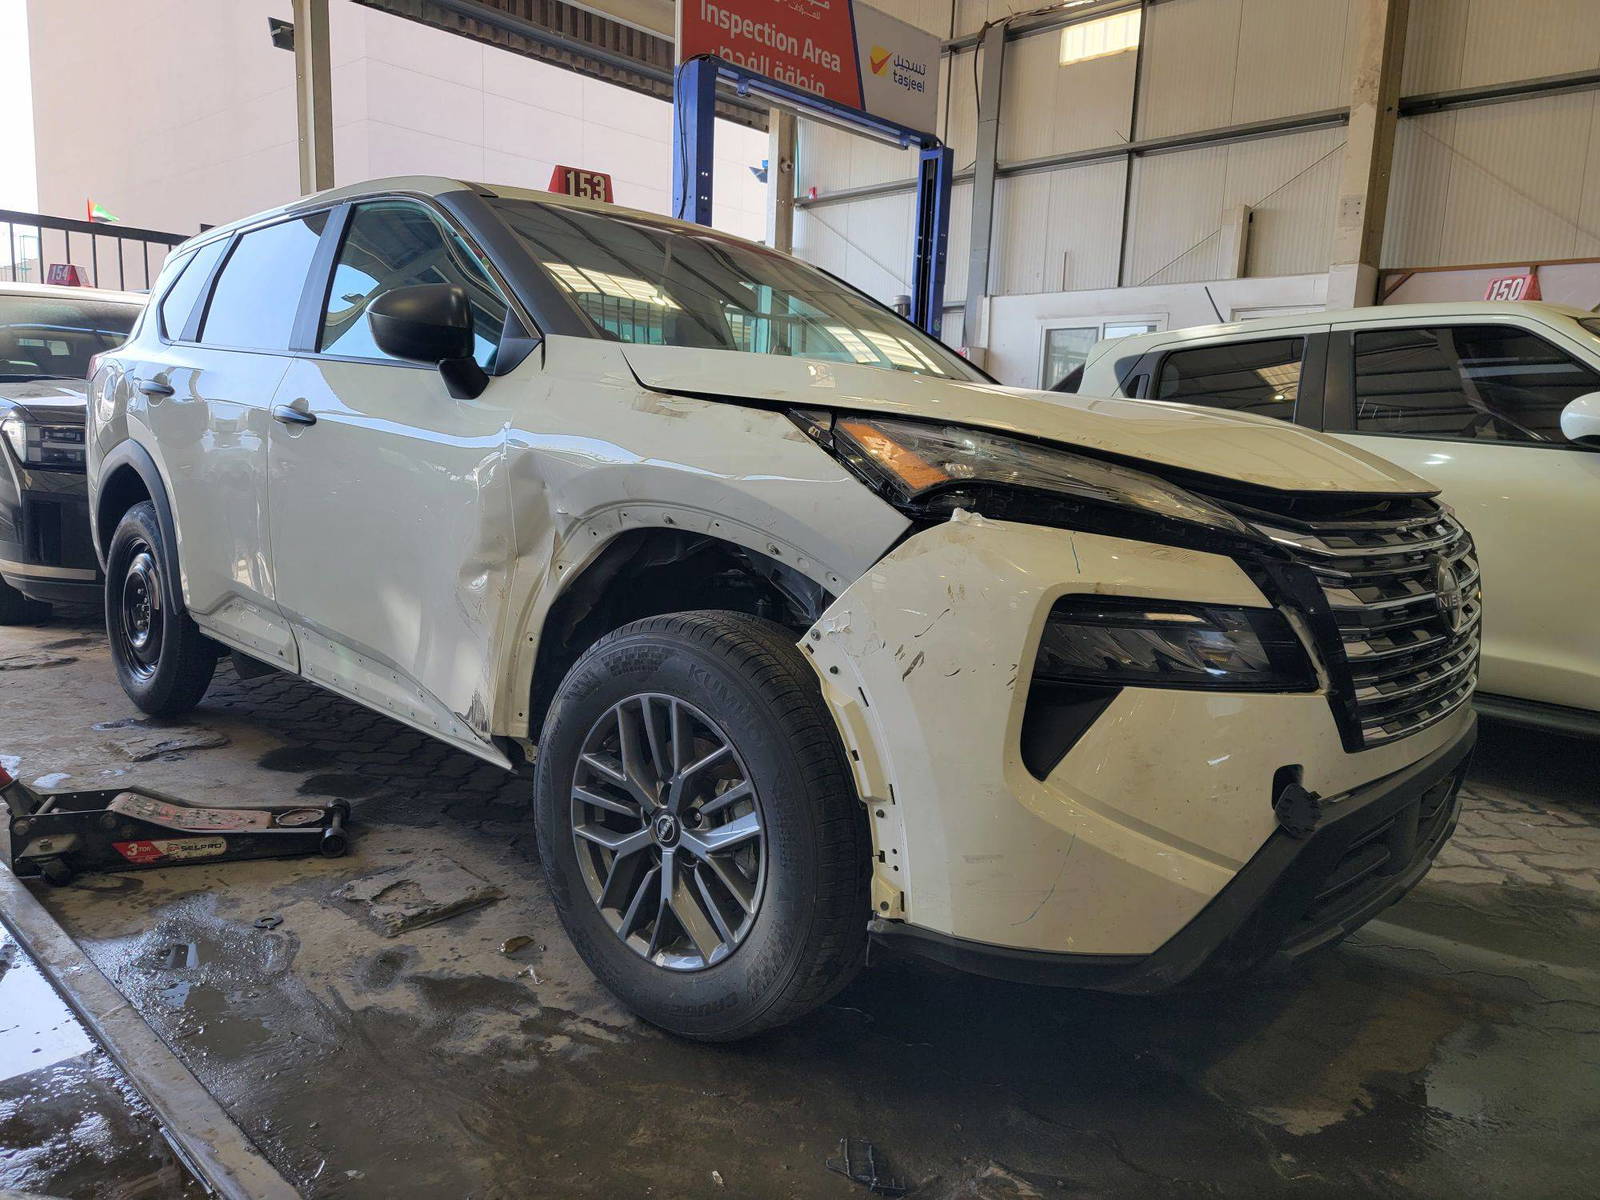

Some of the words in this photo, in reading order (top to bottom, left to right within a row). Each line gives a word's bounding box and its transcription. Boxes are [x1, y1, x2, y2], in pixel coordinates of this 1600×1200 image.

[701, 0, 797, 56] Inspection
[802, 37, 841, 73] Area
[893, 54, 926, 75] تسجيل
[893, 69, 925, 93] tasjeel
[566, 170, 605, 202] 153
[51, 265, 69, 280] 154
[1490, 278, 1523, 301] 150
[127, 843, 138, 856] 3
